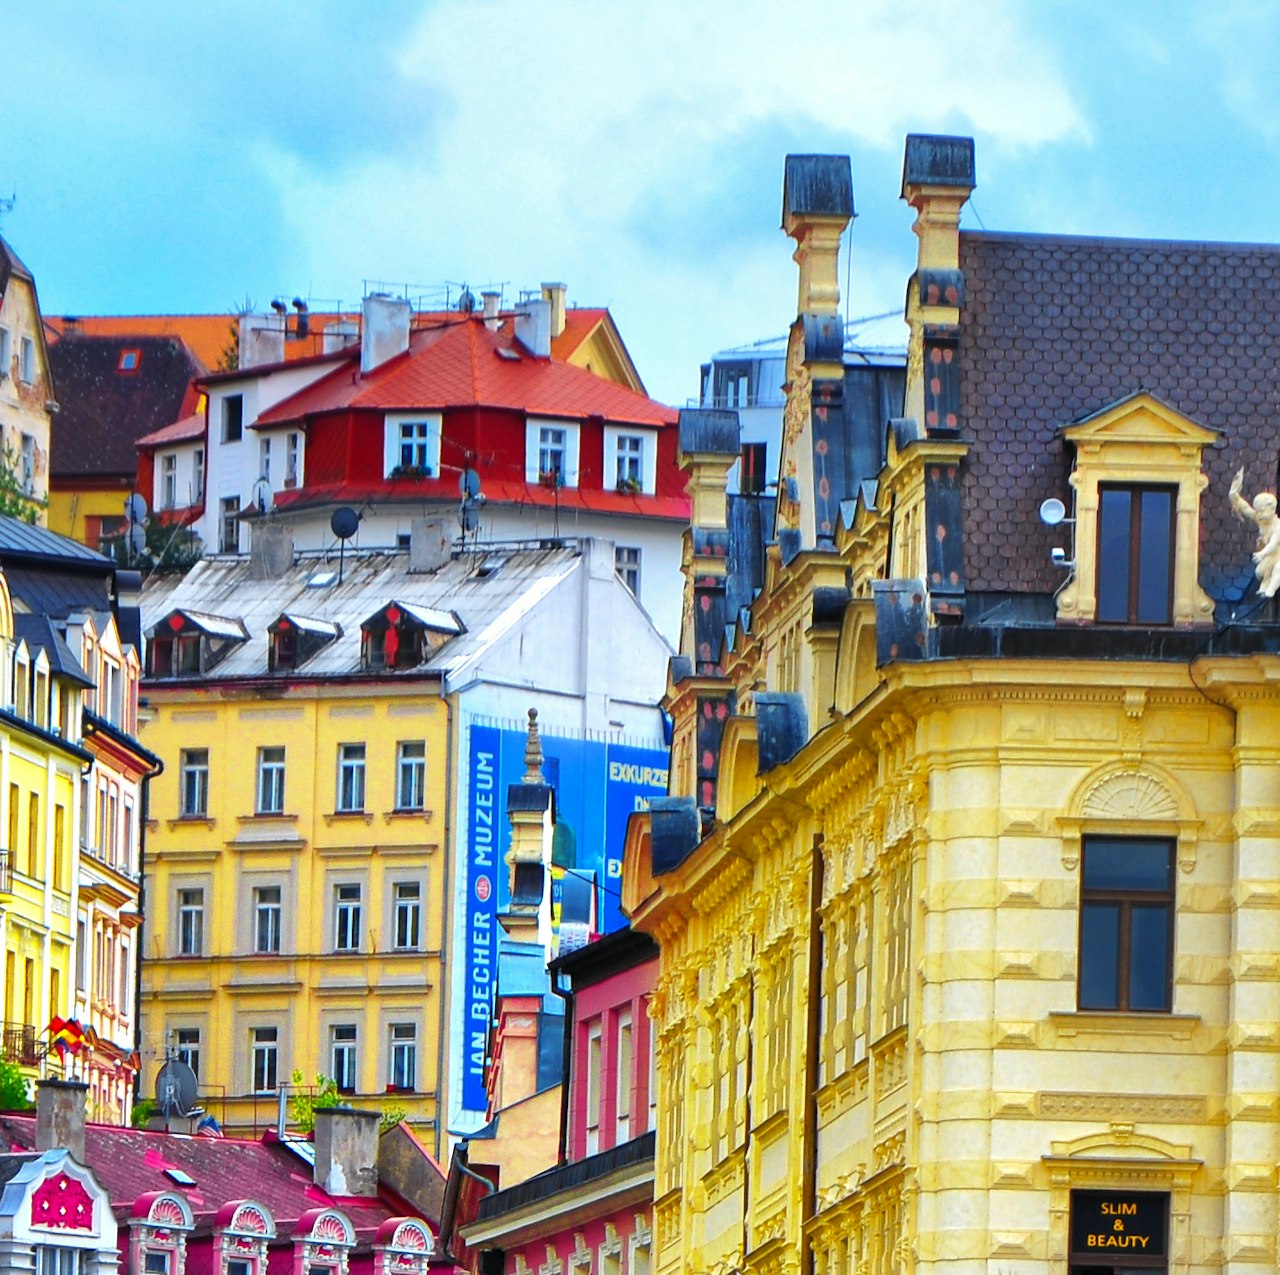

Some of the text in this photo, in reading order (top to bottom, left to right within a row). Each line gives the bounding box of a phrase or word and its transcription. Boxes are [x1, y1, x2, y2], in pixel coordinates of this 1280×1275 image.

[609, 761, 669, 788] EXKURZE
[475, 751, 494, 867] MUZEUM
[471, 911, 491, 1020] BECHER
[1101, 1202, 1138, 1215] SLIM
[1113, 1218, 1125, 1231] &
[1087, 1234, 1150, 1248] BEAUTY
